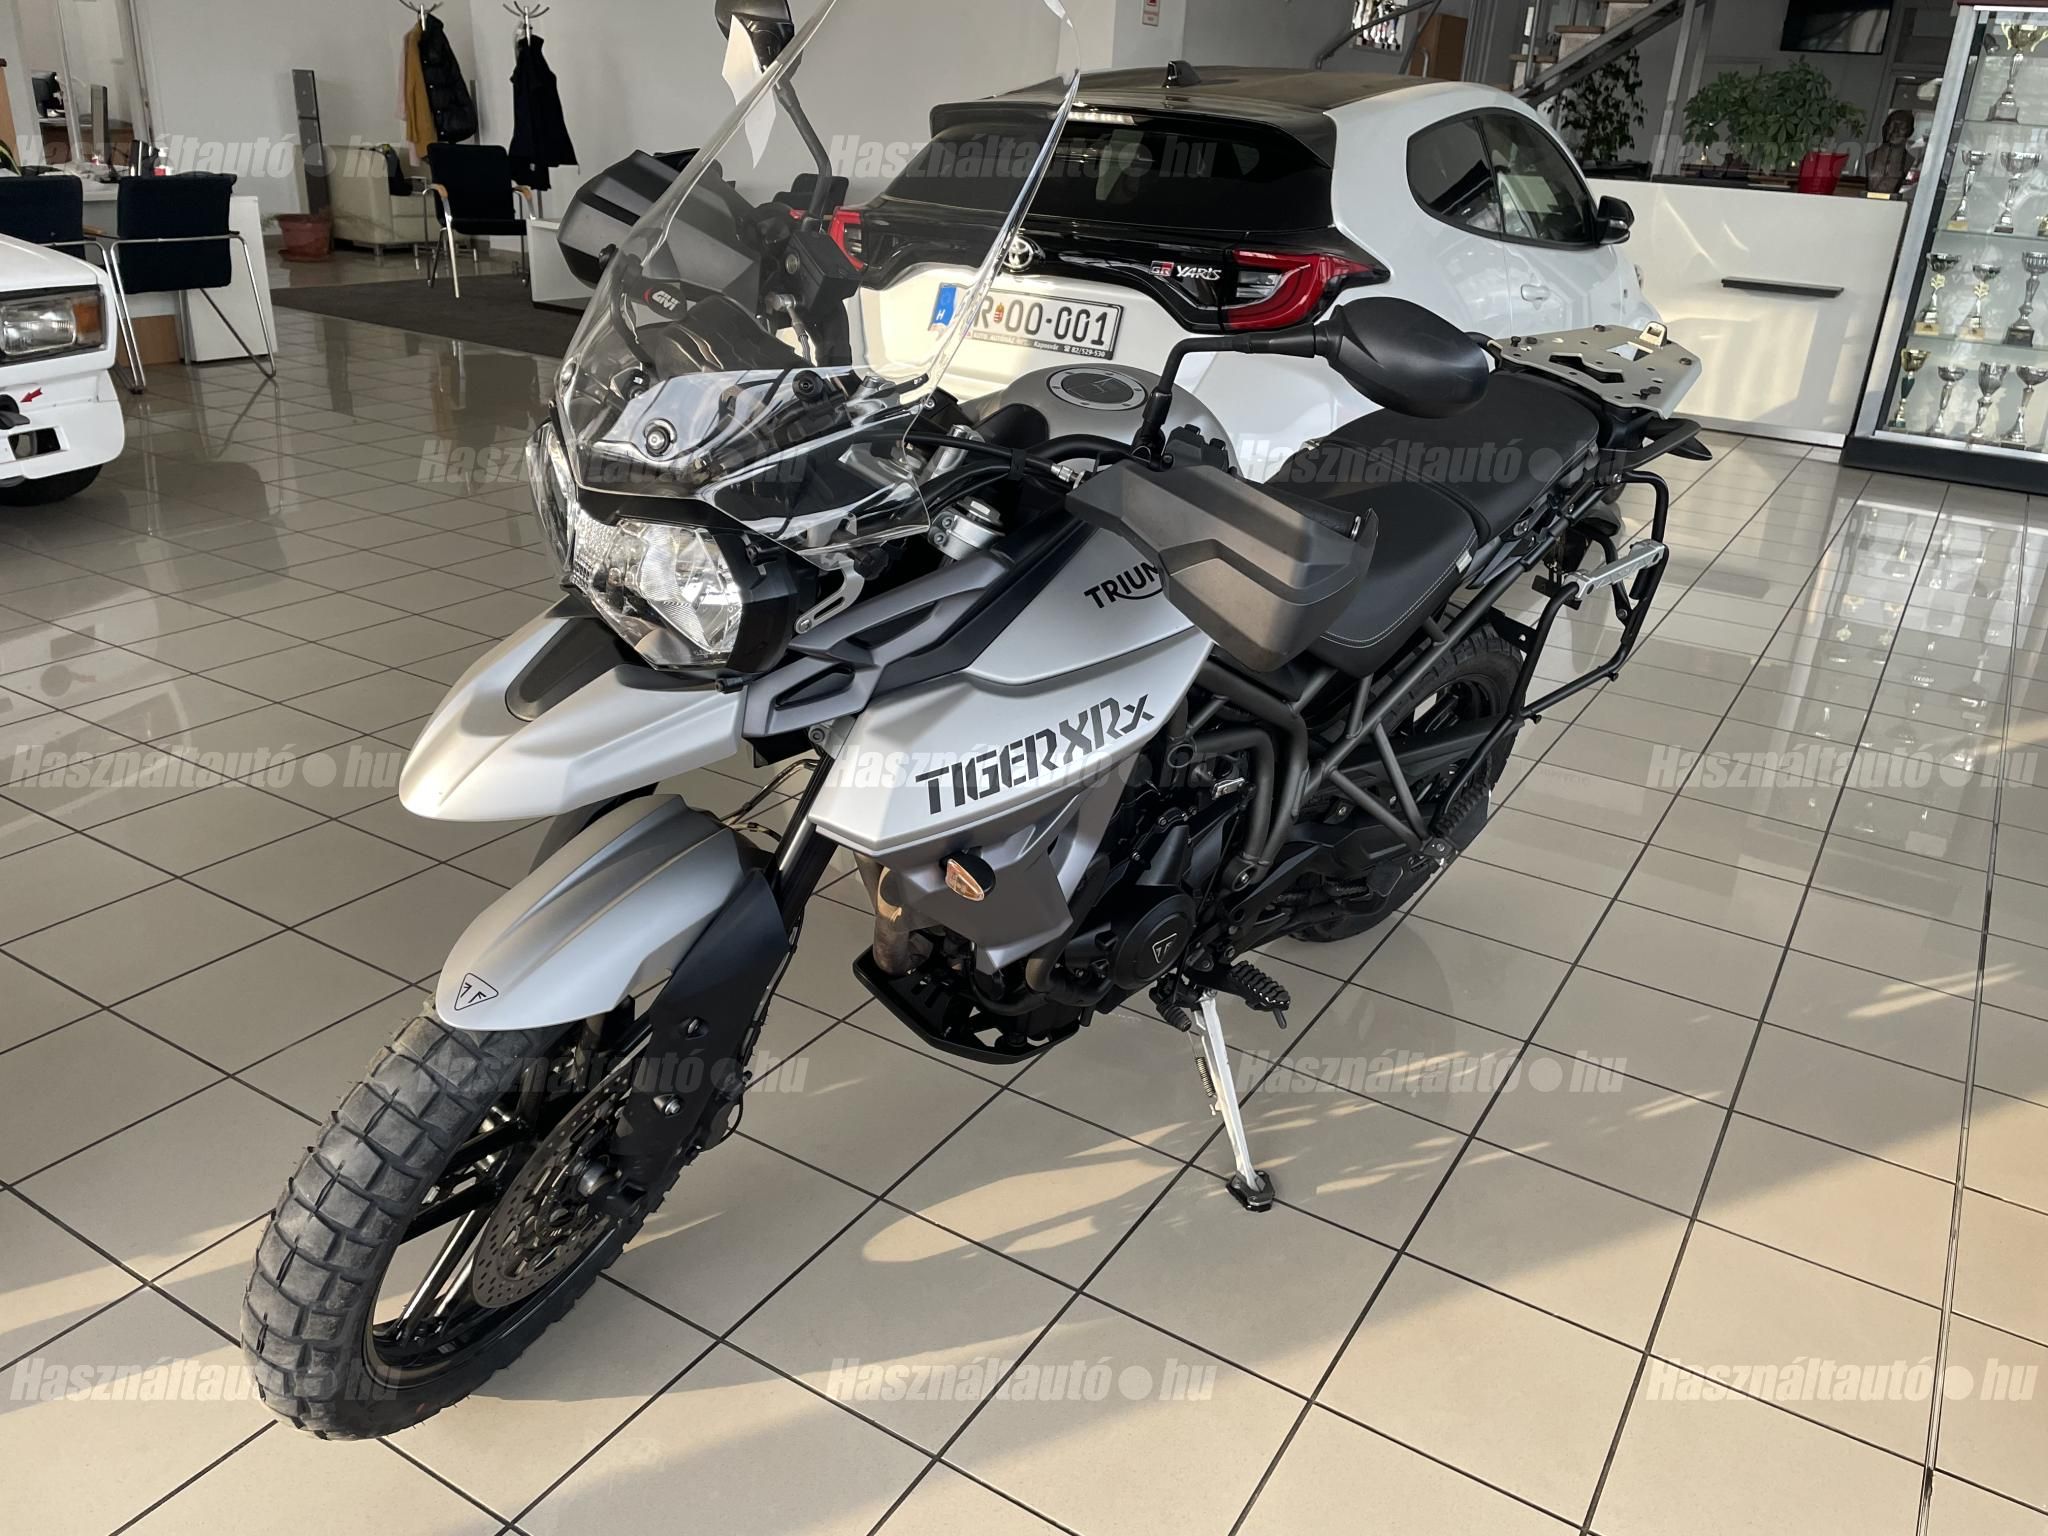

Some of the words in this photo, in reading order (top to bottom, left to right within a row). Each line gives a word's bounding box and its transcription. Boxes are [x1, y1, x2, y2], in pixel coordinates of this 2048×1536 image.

[1176, 265, 1222, 281] YARIS
[652, 290, 680, 311] GIVI
[936, 309, 946, 320] H
